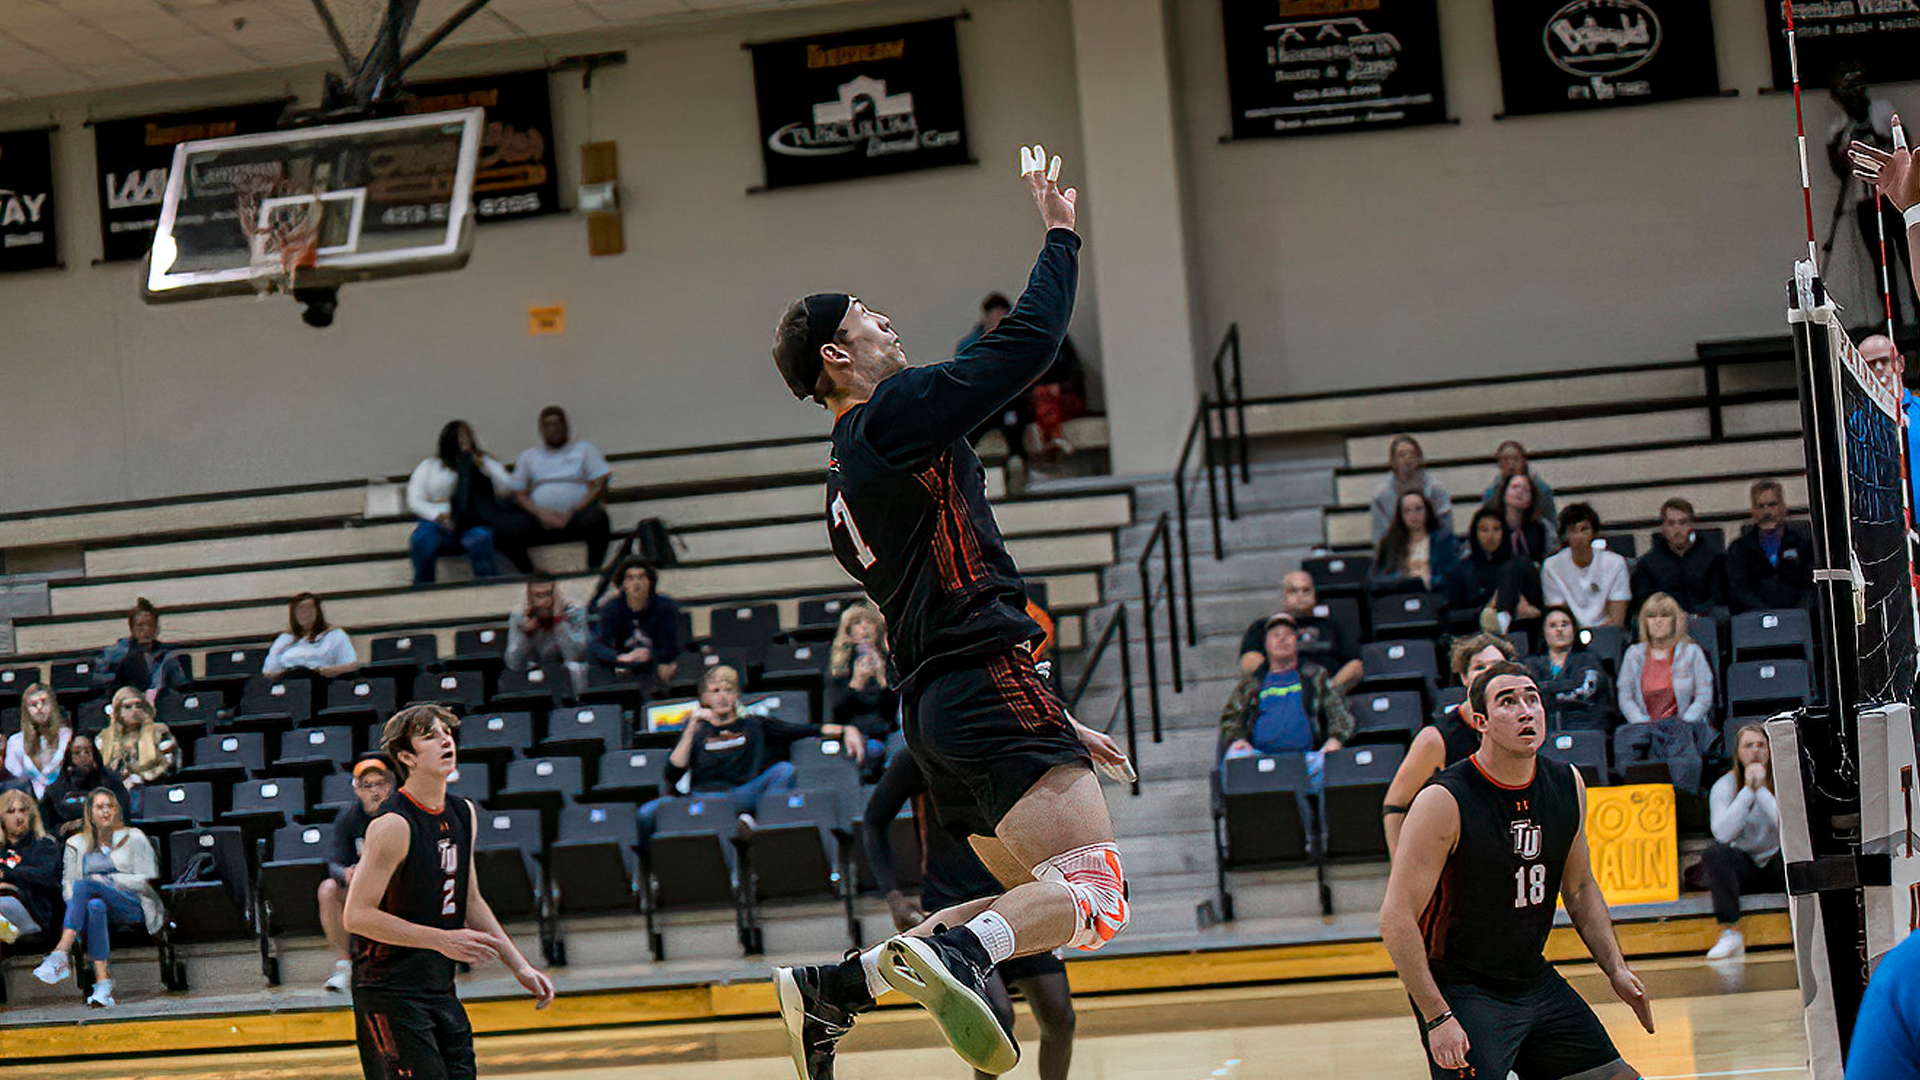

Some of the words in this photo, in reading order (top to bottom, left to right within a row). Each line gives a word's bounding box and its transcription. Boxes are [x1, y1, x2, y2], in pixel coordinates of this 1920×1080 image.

[1509, 818, 1543, 860] TU
[441, 877, 457, 915] 2
[1514, 863, 1546, 909] 18
